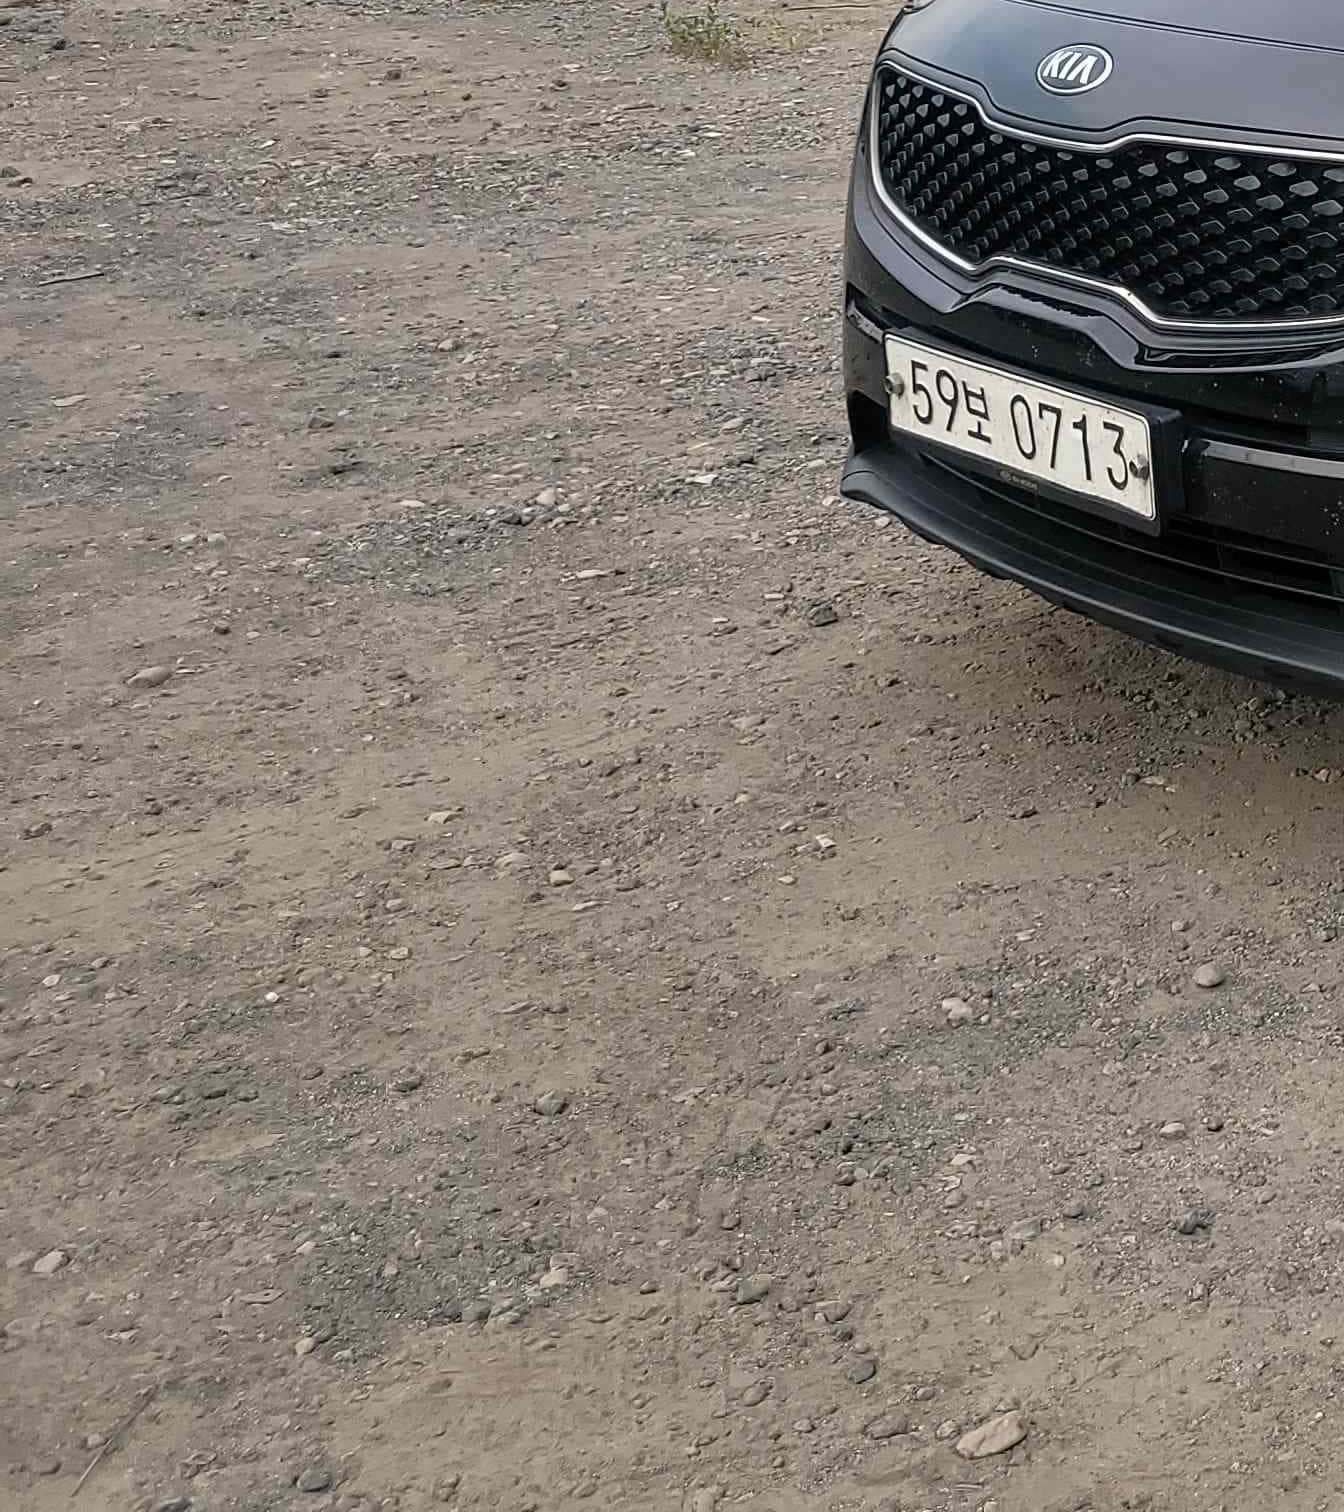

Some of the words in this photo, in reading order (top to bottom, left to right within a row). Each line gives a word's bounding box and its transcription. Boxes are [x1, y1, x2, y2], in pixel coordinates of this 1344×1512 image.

[1042, 50, 1098, 85] KIA
[910, 360, 992, 444] 59보
[1009, 393, 1129, 491] 0713
